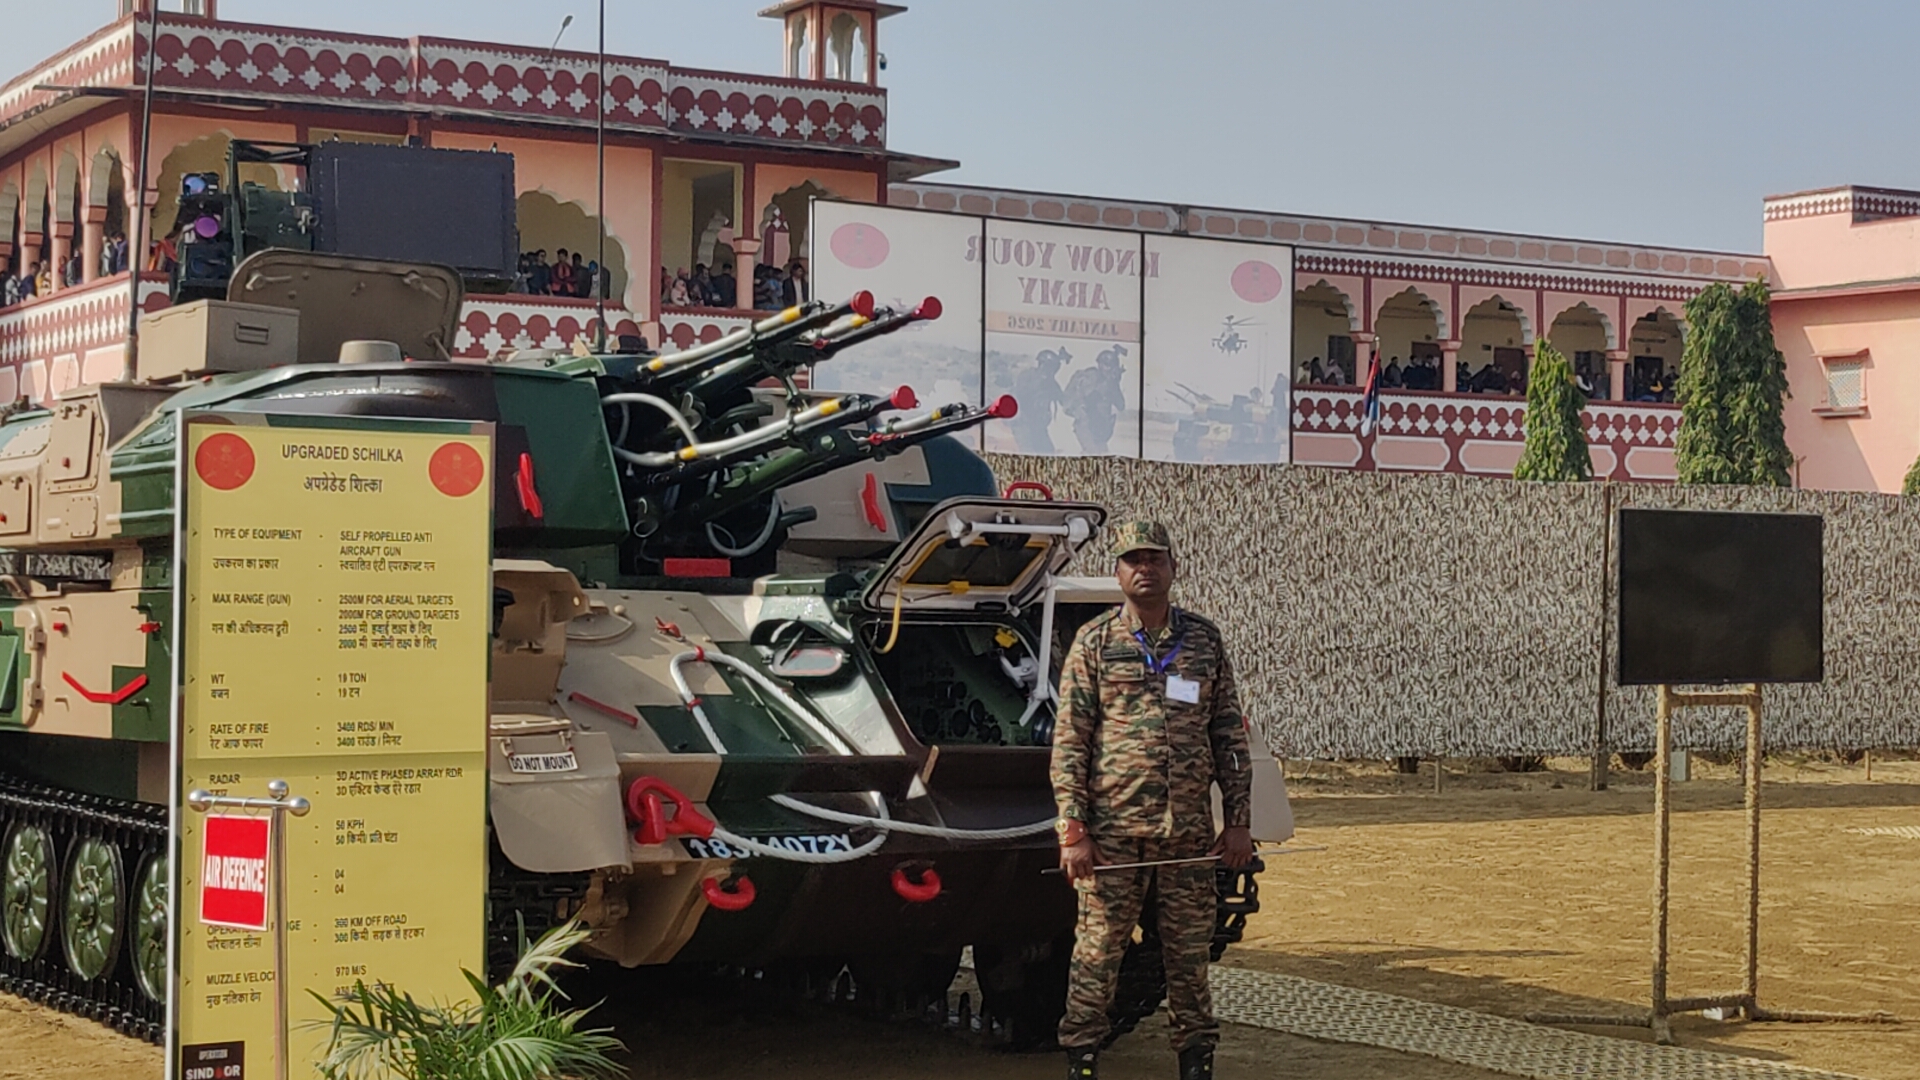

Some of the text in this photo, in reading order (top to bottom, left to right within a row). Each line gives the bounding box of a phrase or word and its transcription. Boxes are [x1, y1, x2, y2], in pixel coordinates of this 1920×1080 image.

[282, 444, 403, 462] UPGRADED SCHILKA
[214, 528, 302, 539] TYPE OF EQUIPMENT
[340, 531, 432, 542] SELF PROPELLED ANTI
[340, 546, 401, 556] AIRCRAFT GUN
[212, 593, 291, 606] MAX RANGE (GUN)
[366, 595, 383, 604] FOR
[385, 595, 414, 605] AERIAL
[417, 595, 453, 605] TARGETS
[366, 610, 383, 619] FOR
[385, 610, 420, 619] GROUND
[423, 610, 459, 620] TARGETS
[211, 674, 224, 684] WT
[338, 673, 366, 683] 19 TON
[210, 723, 269, 734] RATE OF FIRE
[379, 721, 394, 731] MIN
[510, 755, 574, 770] DO NOT MOUNT
[209, 774, 241, 784] RADAR
[336, 768, 463, 781] 3D ACTIVE PHASED ARRAY RDR
[347, 819, 364, 829] KPH
[205, 855, 264, 892] AIR DEFENCE
[335, 869, 344, 879] 04
[335, 884, 344, 894] 04
[350, 917, 363, 927] KM
[365, 916, 382, 926] OFF
[383, 914, 407, 925] ROAD
[352, 965, 366, 975] M/S
[207, 971, 276, 985] MUZZLE VELOCI
